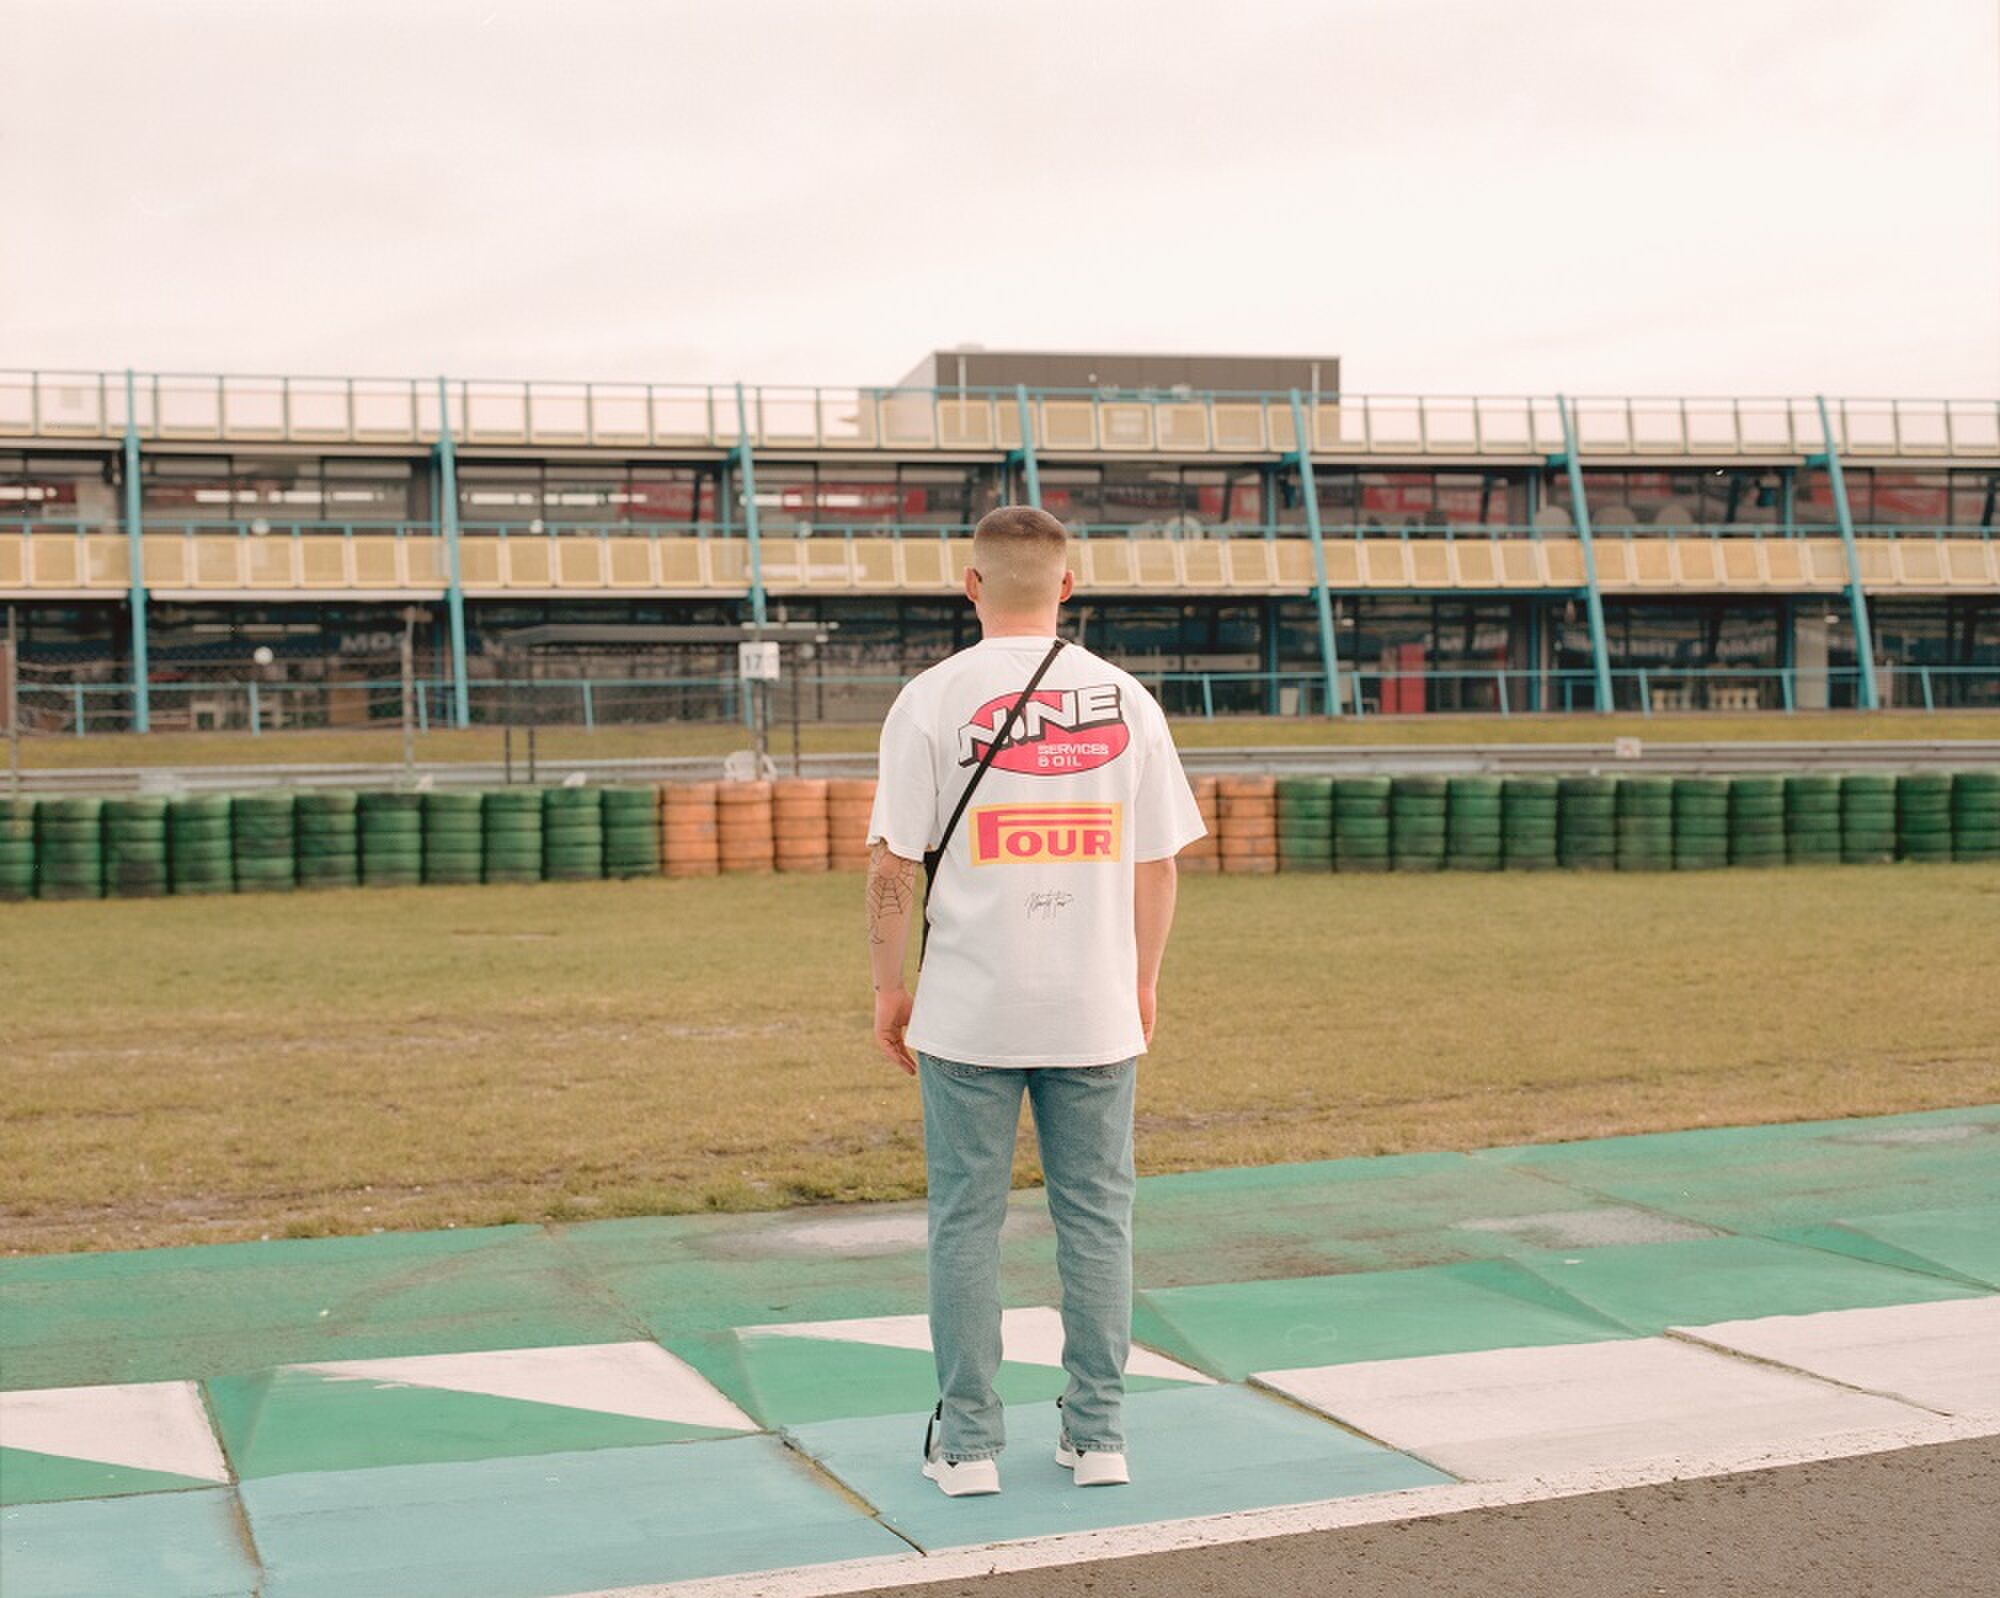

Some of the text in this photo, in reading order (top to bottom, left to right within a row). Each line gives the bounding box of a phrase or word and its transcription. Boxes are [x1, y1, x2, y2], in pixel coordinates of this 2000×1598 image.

[745, 654, 763, 671] 17
[1038, 743, 1110, 756] SERVICES
[1053, 755, 1082, 767] OIL
[976, 807, 1113, 861] FOUR
